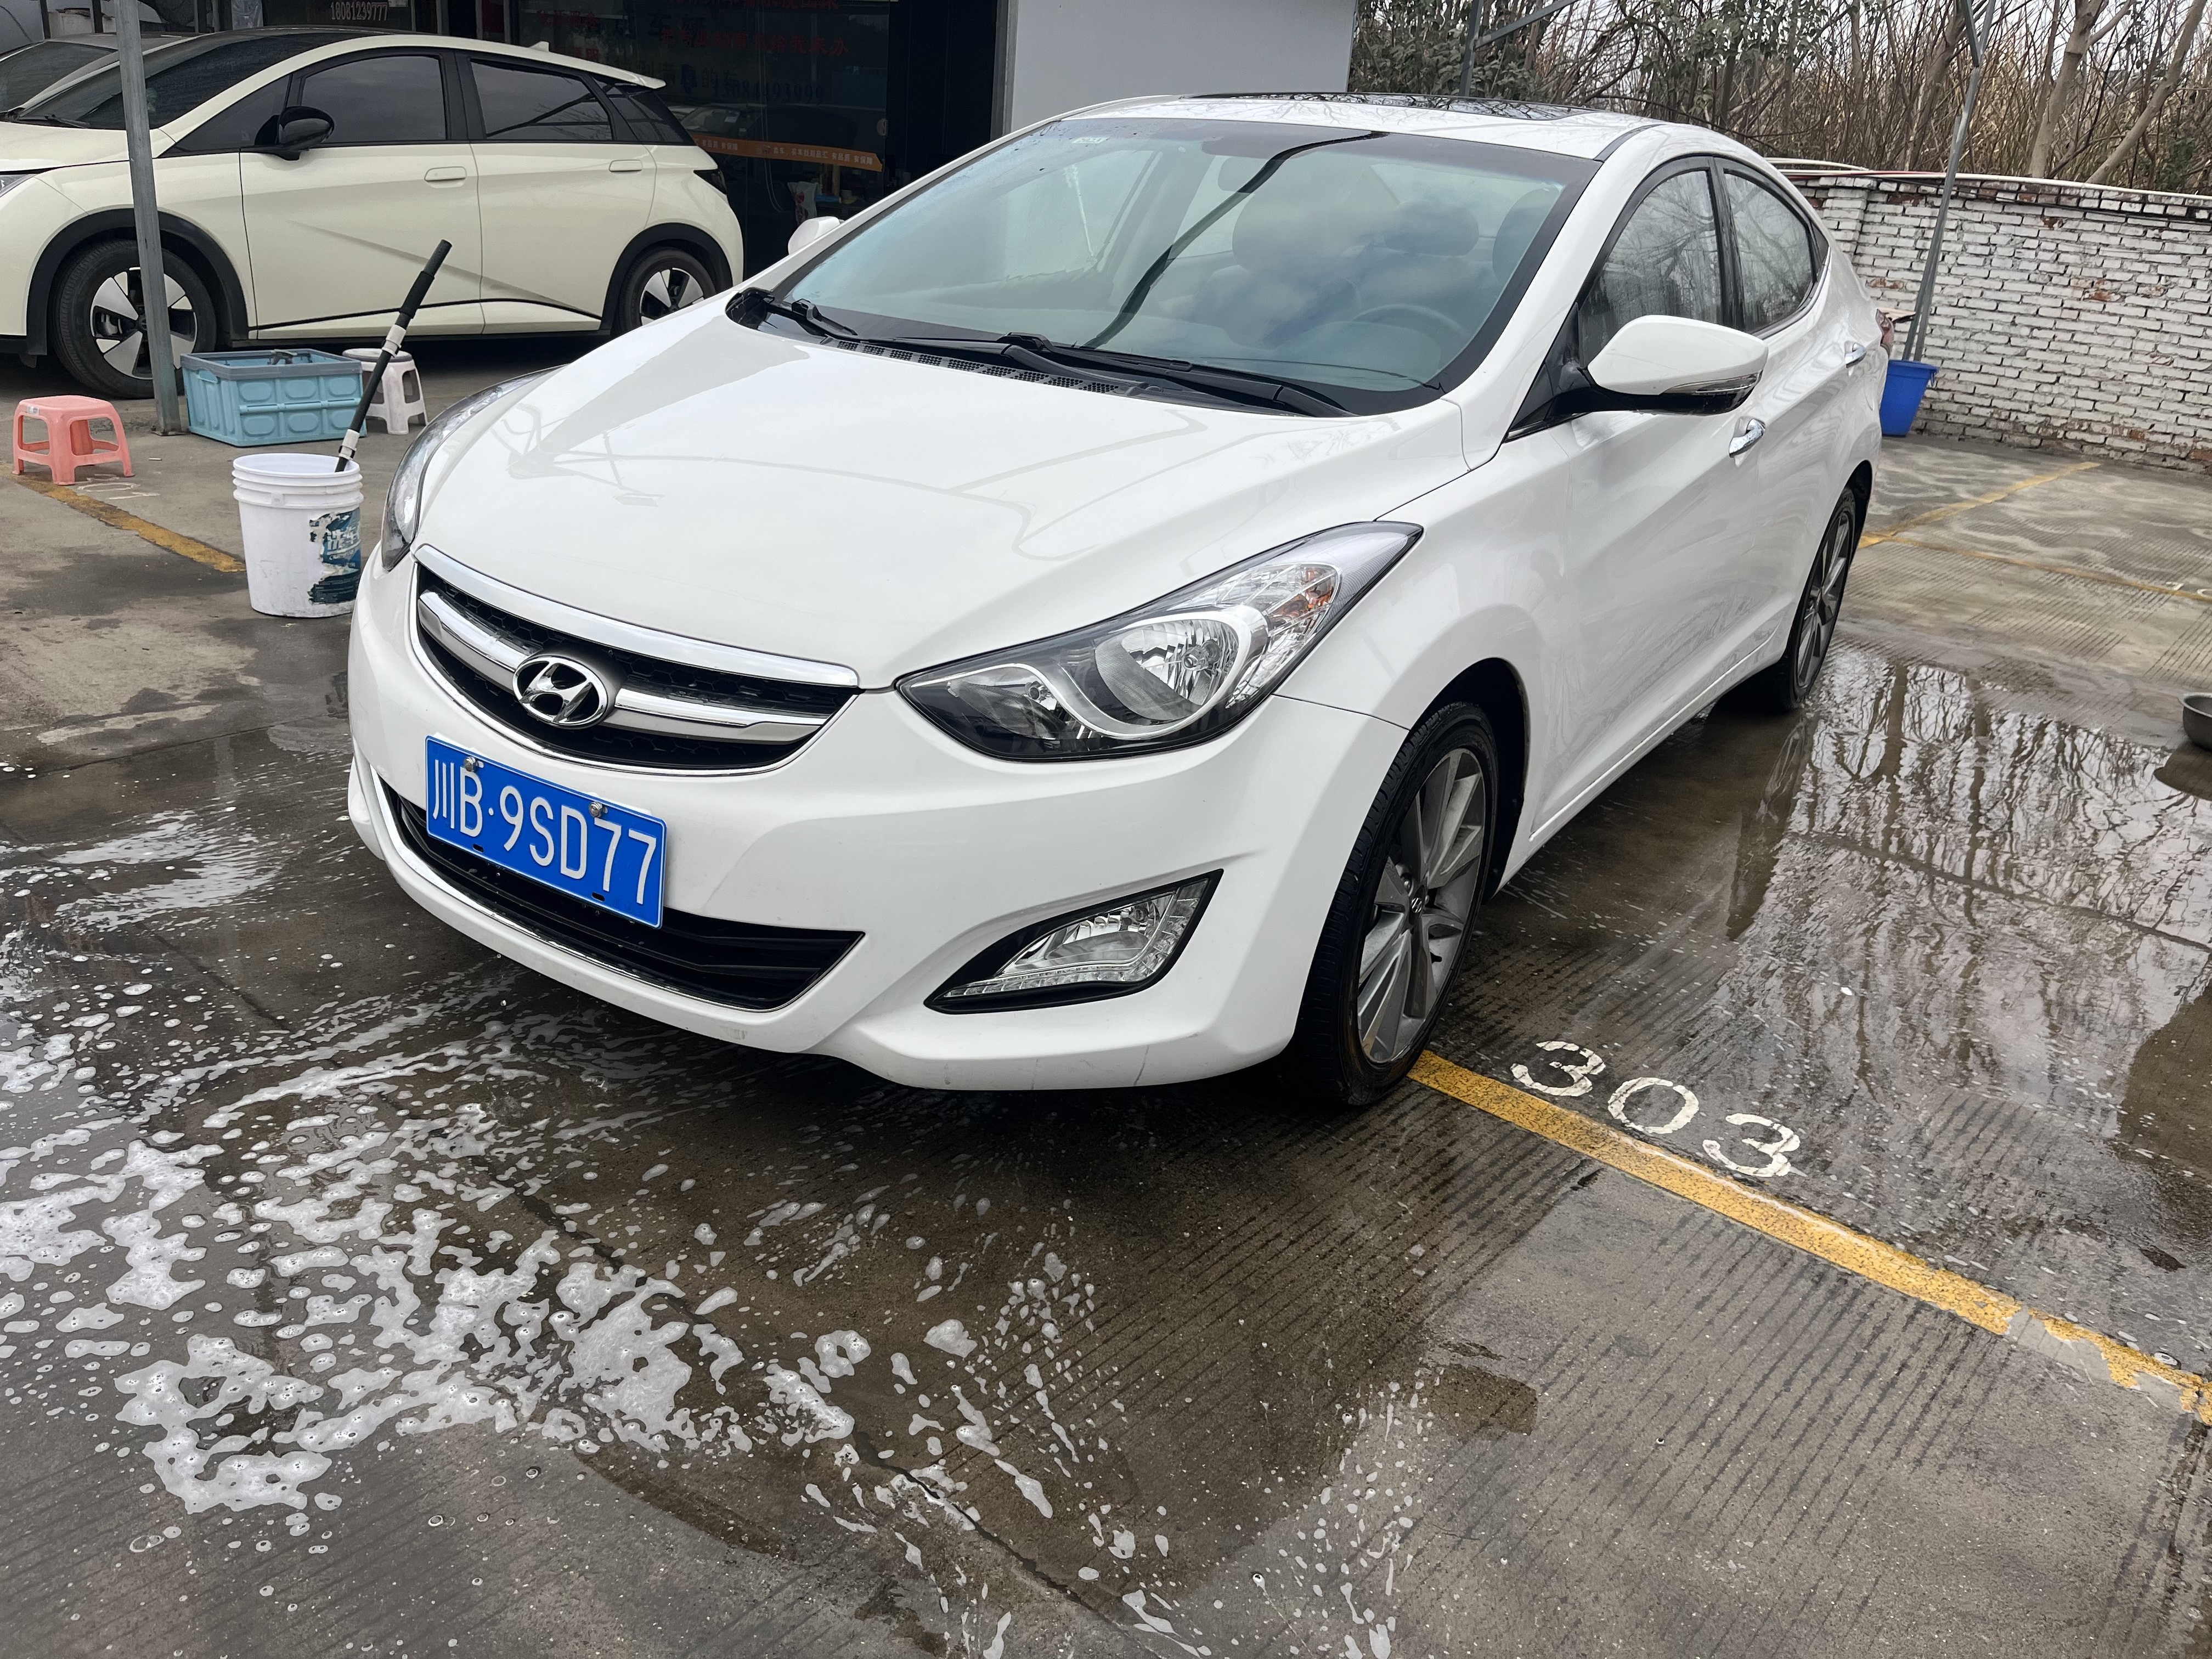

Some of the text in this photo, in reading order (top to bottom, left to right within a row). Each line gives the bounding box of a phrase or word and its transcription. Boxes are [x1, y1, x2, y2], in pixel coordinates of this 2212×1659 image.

[330, 1, 387, 21] 18081239777
[433, 759, 657, 905] 川B·9SD77
[1510, 1041, 1800, 1177] 303
